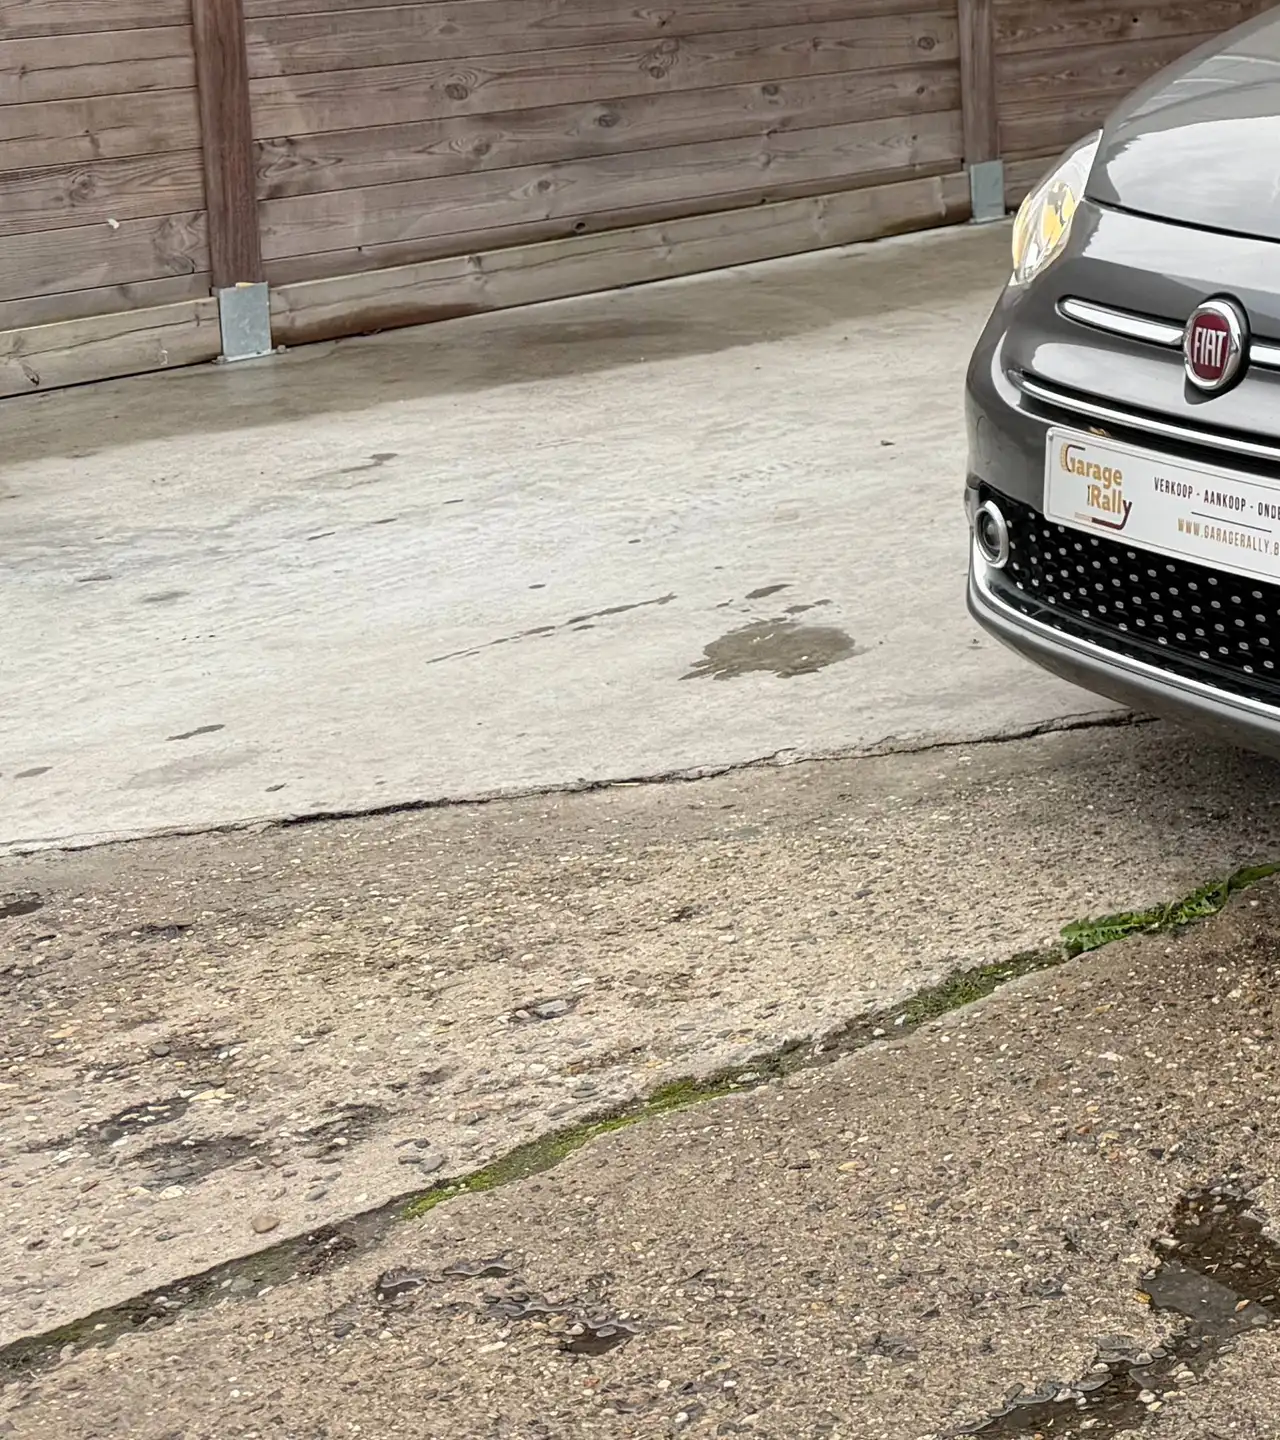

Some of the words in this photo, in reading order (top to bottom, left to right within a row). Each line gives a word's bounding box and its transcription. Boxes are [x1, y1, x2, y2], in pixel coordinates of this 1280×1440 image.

[1194, 327, 1226, 368] FIAT
[1062, 443, 1122, 489] Garage
[1089, 484, 1132, 530] Rally
[1154, 477, 1193, 499] VERKOOP
[1204, 489, 1247, 512] AANKOOP
